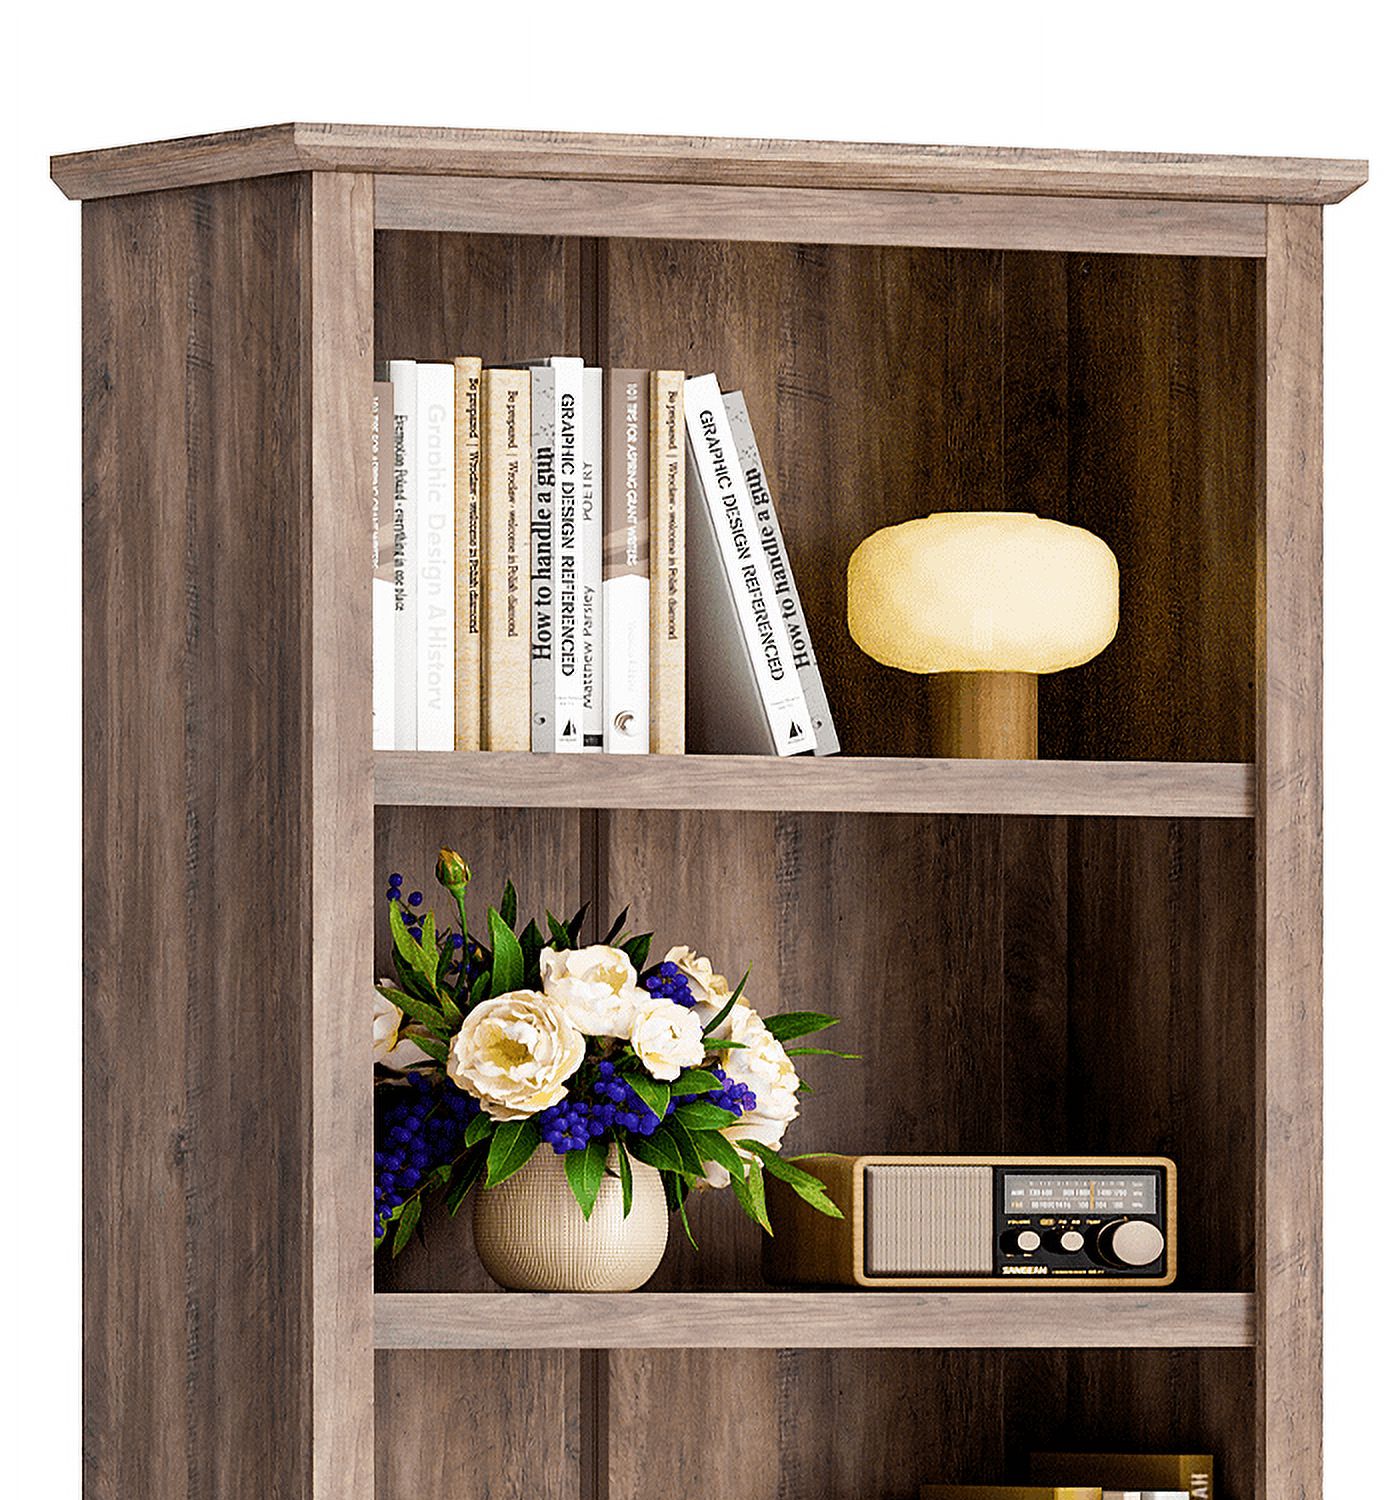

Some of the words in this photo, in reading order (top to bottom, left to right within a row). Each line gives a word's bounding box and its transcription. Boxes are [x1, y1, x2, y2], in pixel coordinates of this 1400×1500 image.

[561, 393, 575, 476] GRAPHIC
[626, 423, 638, 443] FOR
[535, 447, 556, 488] gun
[626, 444, 638, 489] ASPIRING
[745, 467, 770, 506] gun
[538, 492, 552, 504] a
[561, 482, 575, 550] DESIGN
[626, 489, 638, 524] GRANT
[756, 510, 770, 523] a
[422, 513, 447, 596] Design
[531, 509, 552, 580] handle
[699, 410, 732, 490] GRAPHIC
[722, 495, 751, 560] DESIGN
[741, 565, 786, 682] REFERENCED
[761, 526, 790, 595] handle
[427, 604, 447, 621] A
[534, 586, 552, 607] to
[561, 555, 575, 677] REFERENCED
[780, 598, 797, 619] to
[531, 611, 552, 661] How
[786, 623, 811, 670] How
